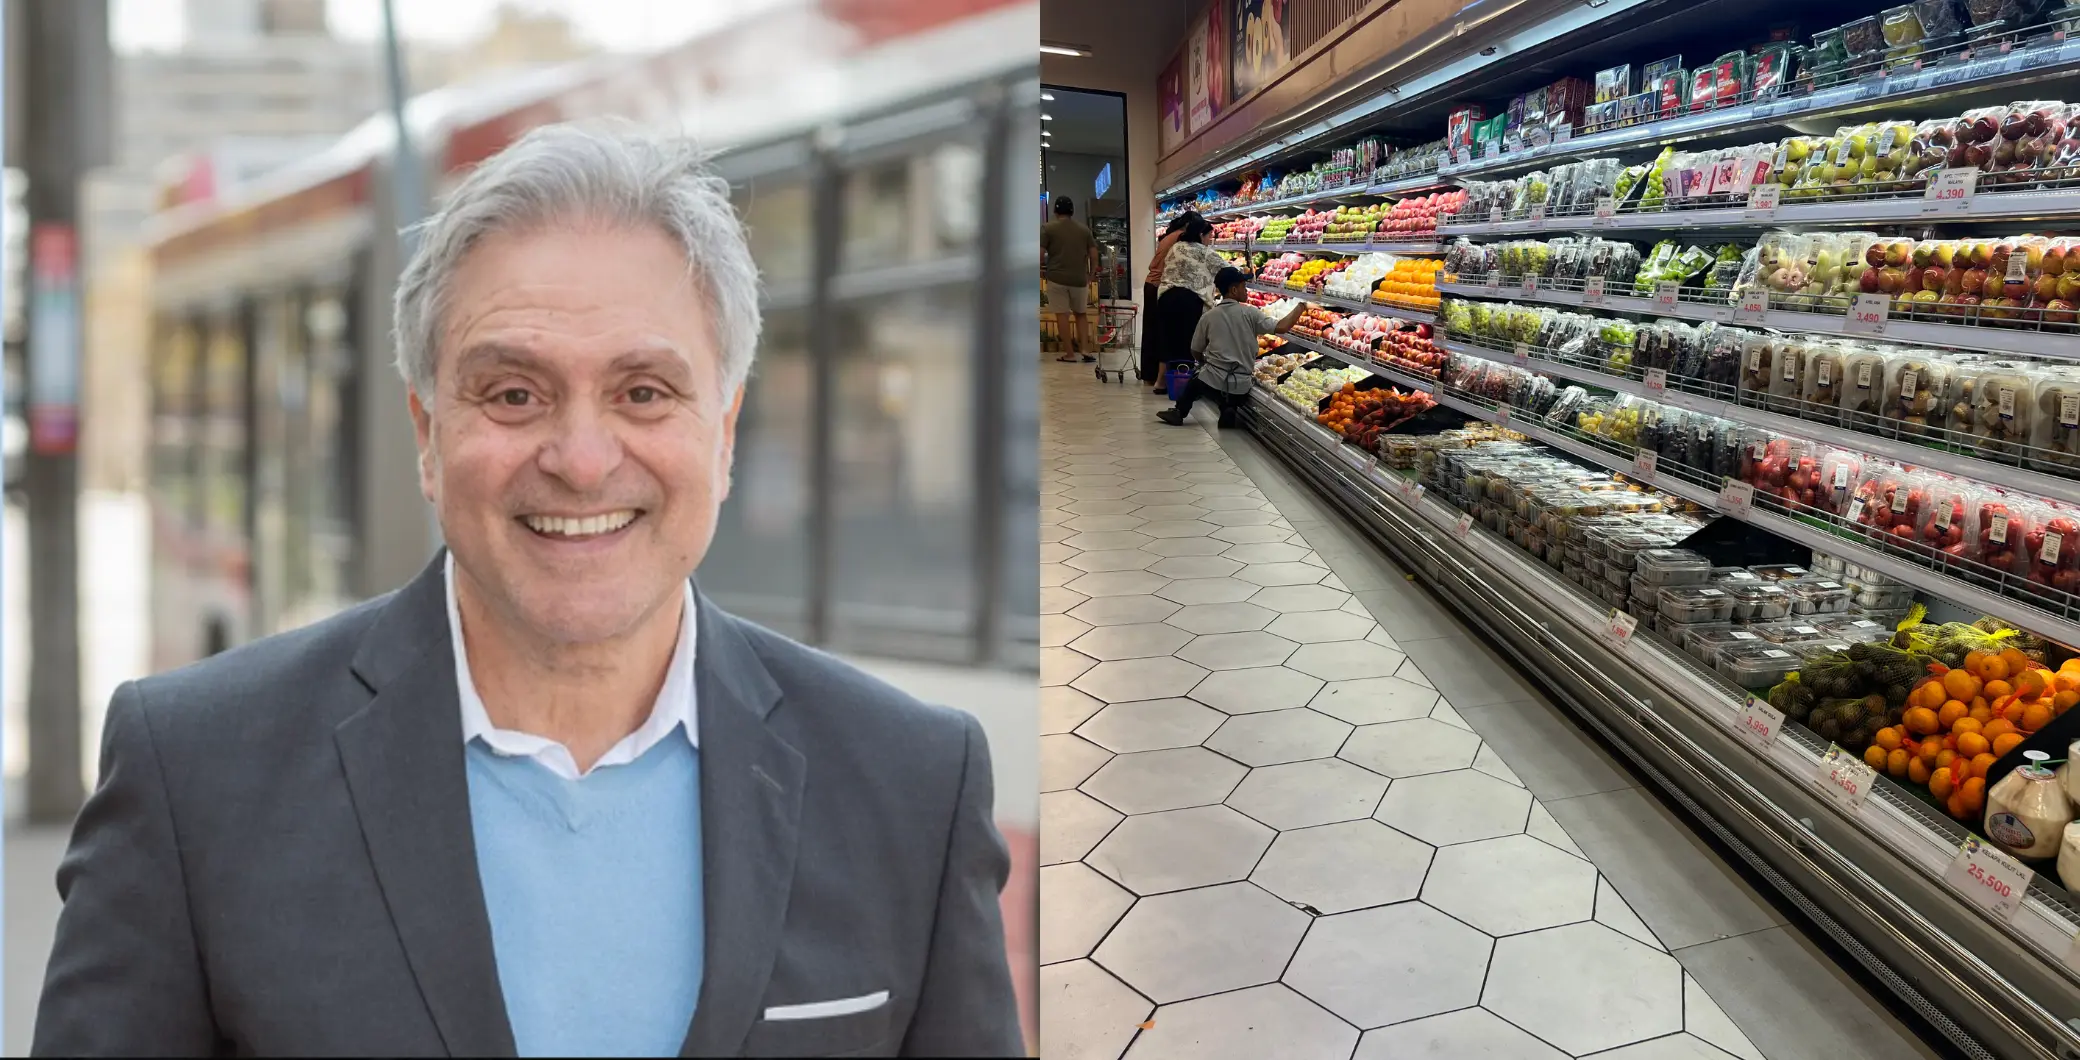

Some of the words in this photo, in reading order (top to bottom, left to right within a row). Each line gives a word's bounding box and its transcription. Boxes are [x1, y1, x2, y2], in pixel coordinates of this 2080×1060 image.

[1856, 312, 1880, 323] 3,490
[1746, 715, 1769, 737] 3,990
[1982, 848, 2001, 863] KELAPA
[2000, 860, 2016, 873] KULIT
[1967, 863, 2011, 897] 25,500
